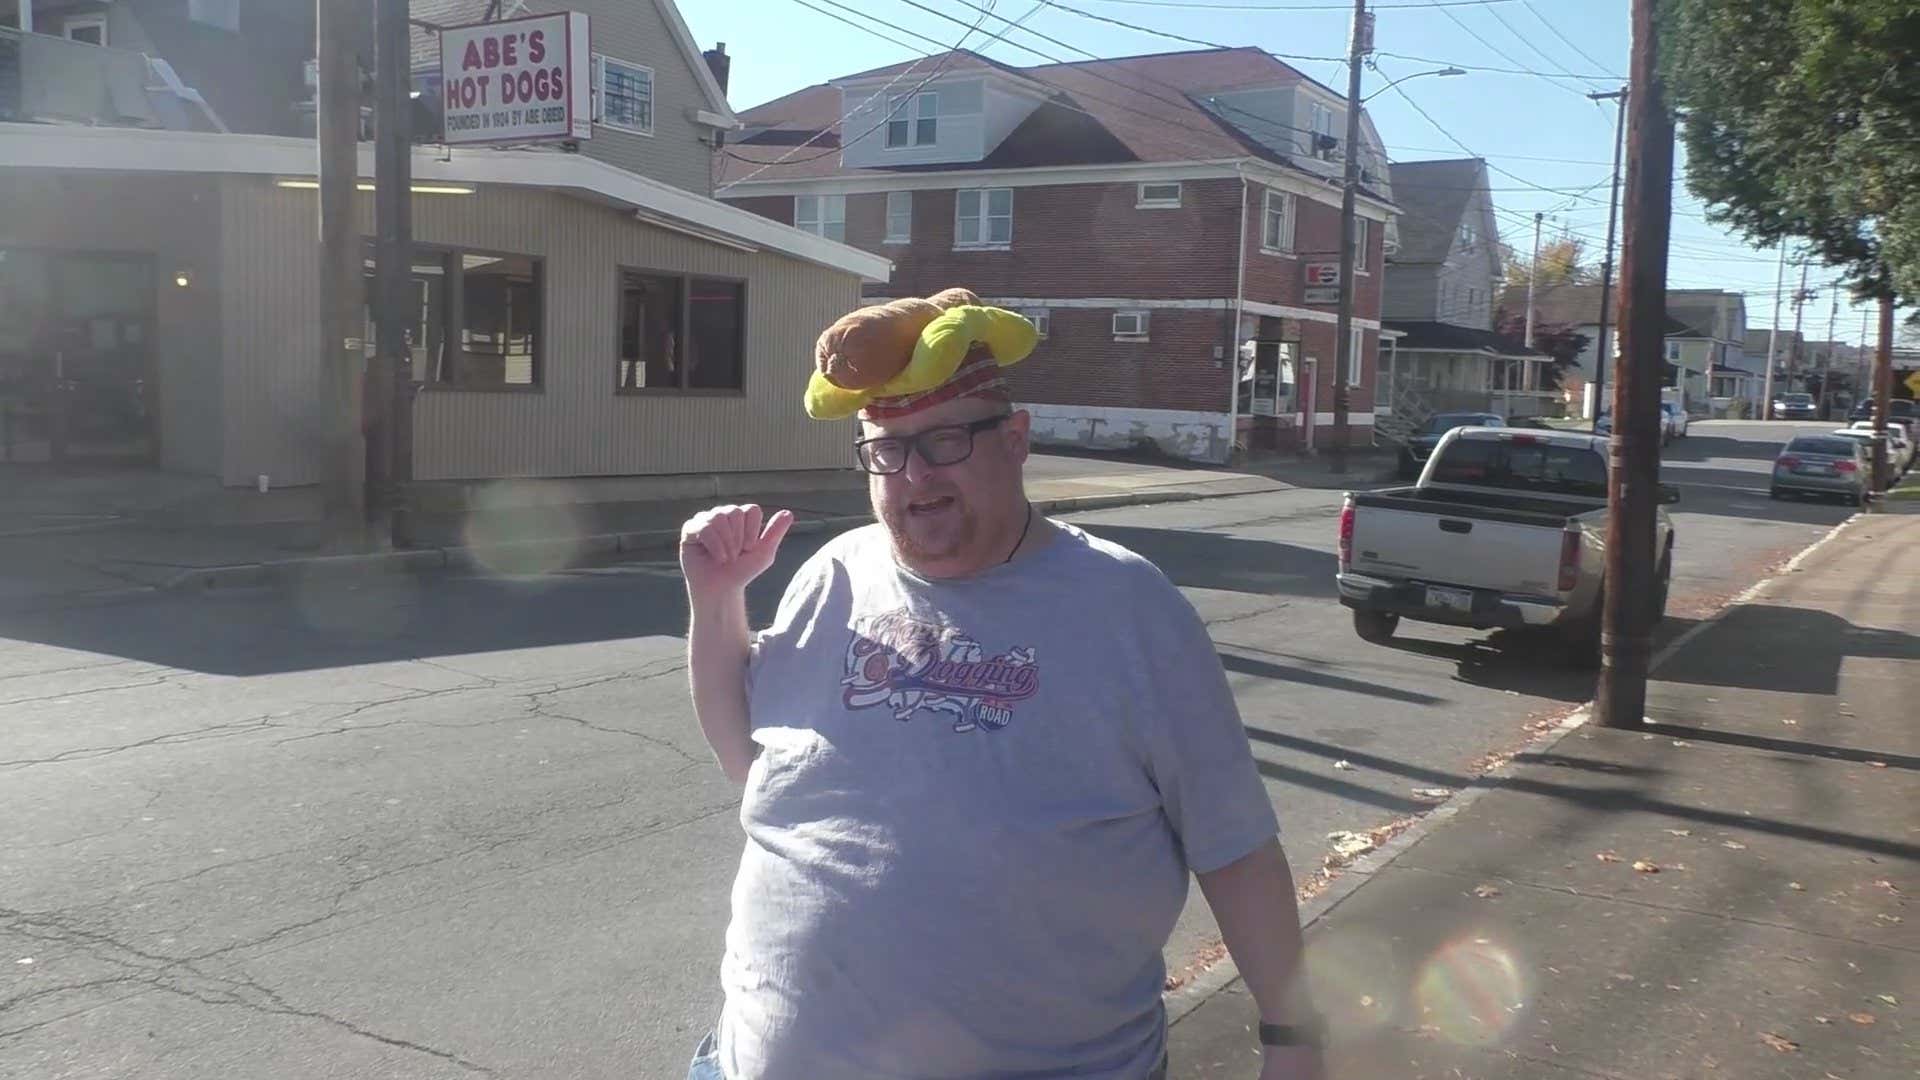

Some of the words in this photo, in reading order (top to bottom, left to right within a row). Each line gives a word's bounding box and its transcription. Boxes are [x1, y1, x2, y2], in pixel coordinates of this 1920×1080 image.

[462, 30, 546, 71] ABE'S
[447, 75, 490, 109] HOT
[501, 66, 563, 104] DOGS
[447, 114, 480, 131] FOUNDED
[525, 108, 540, 125] ABE
[980, 704, 1010, 725] ROAD
